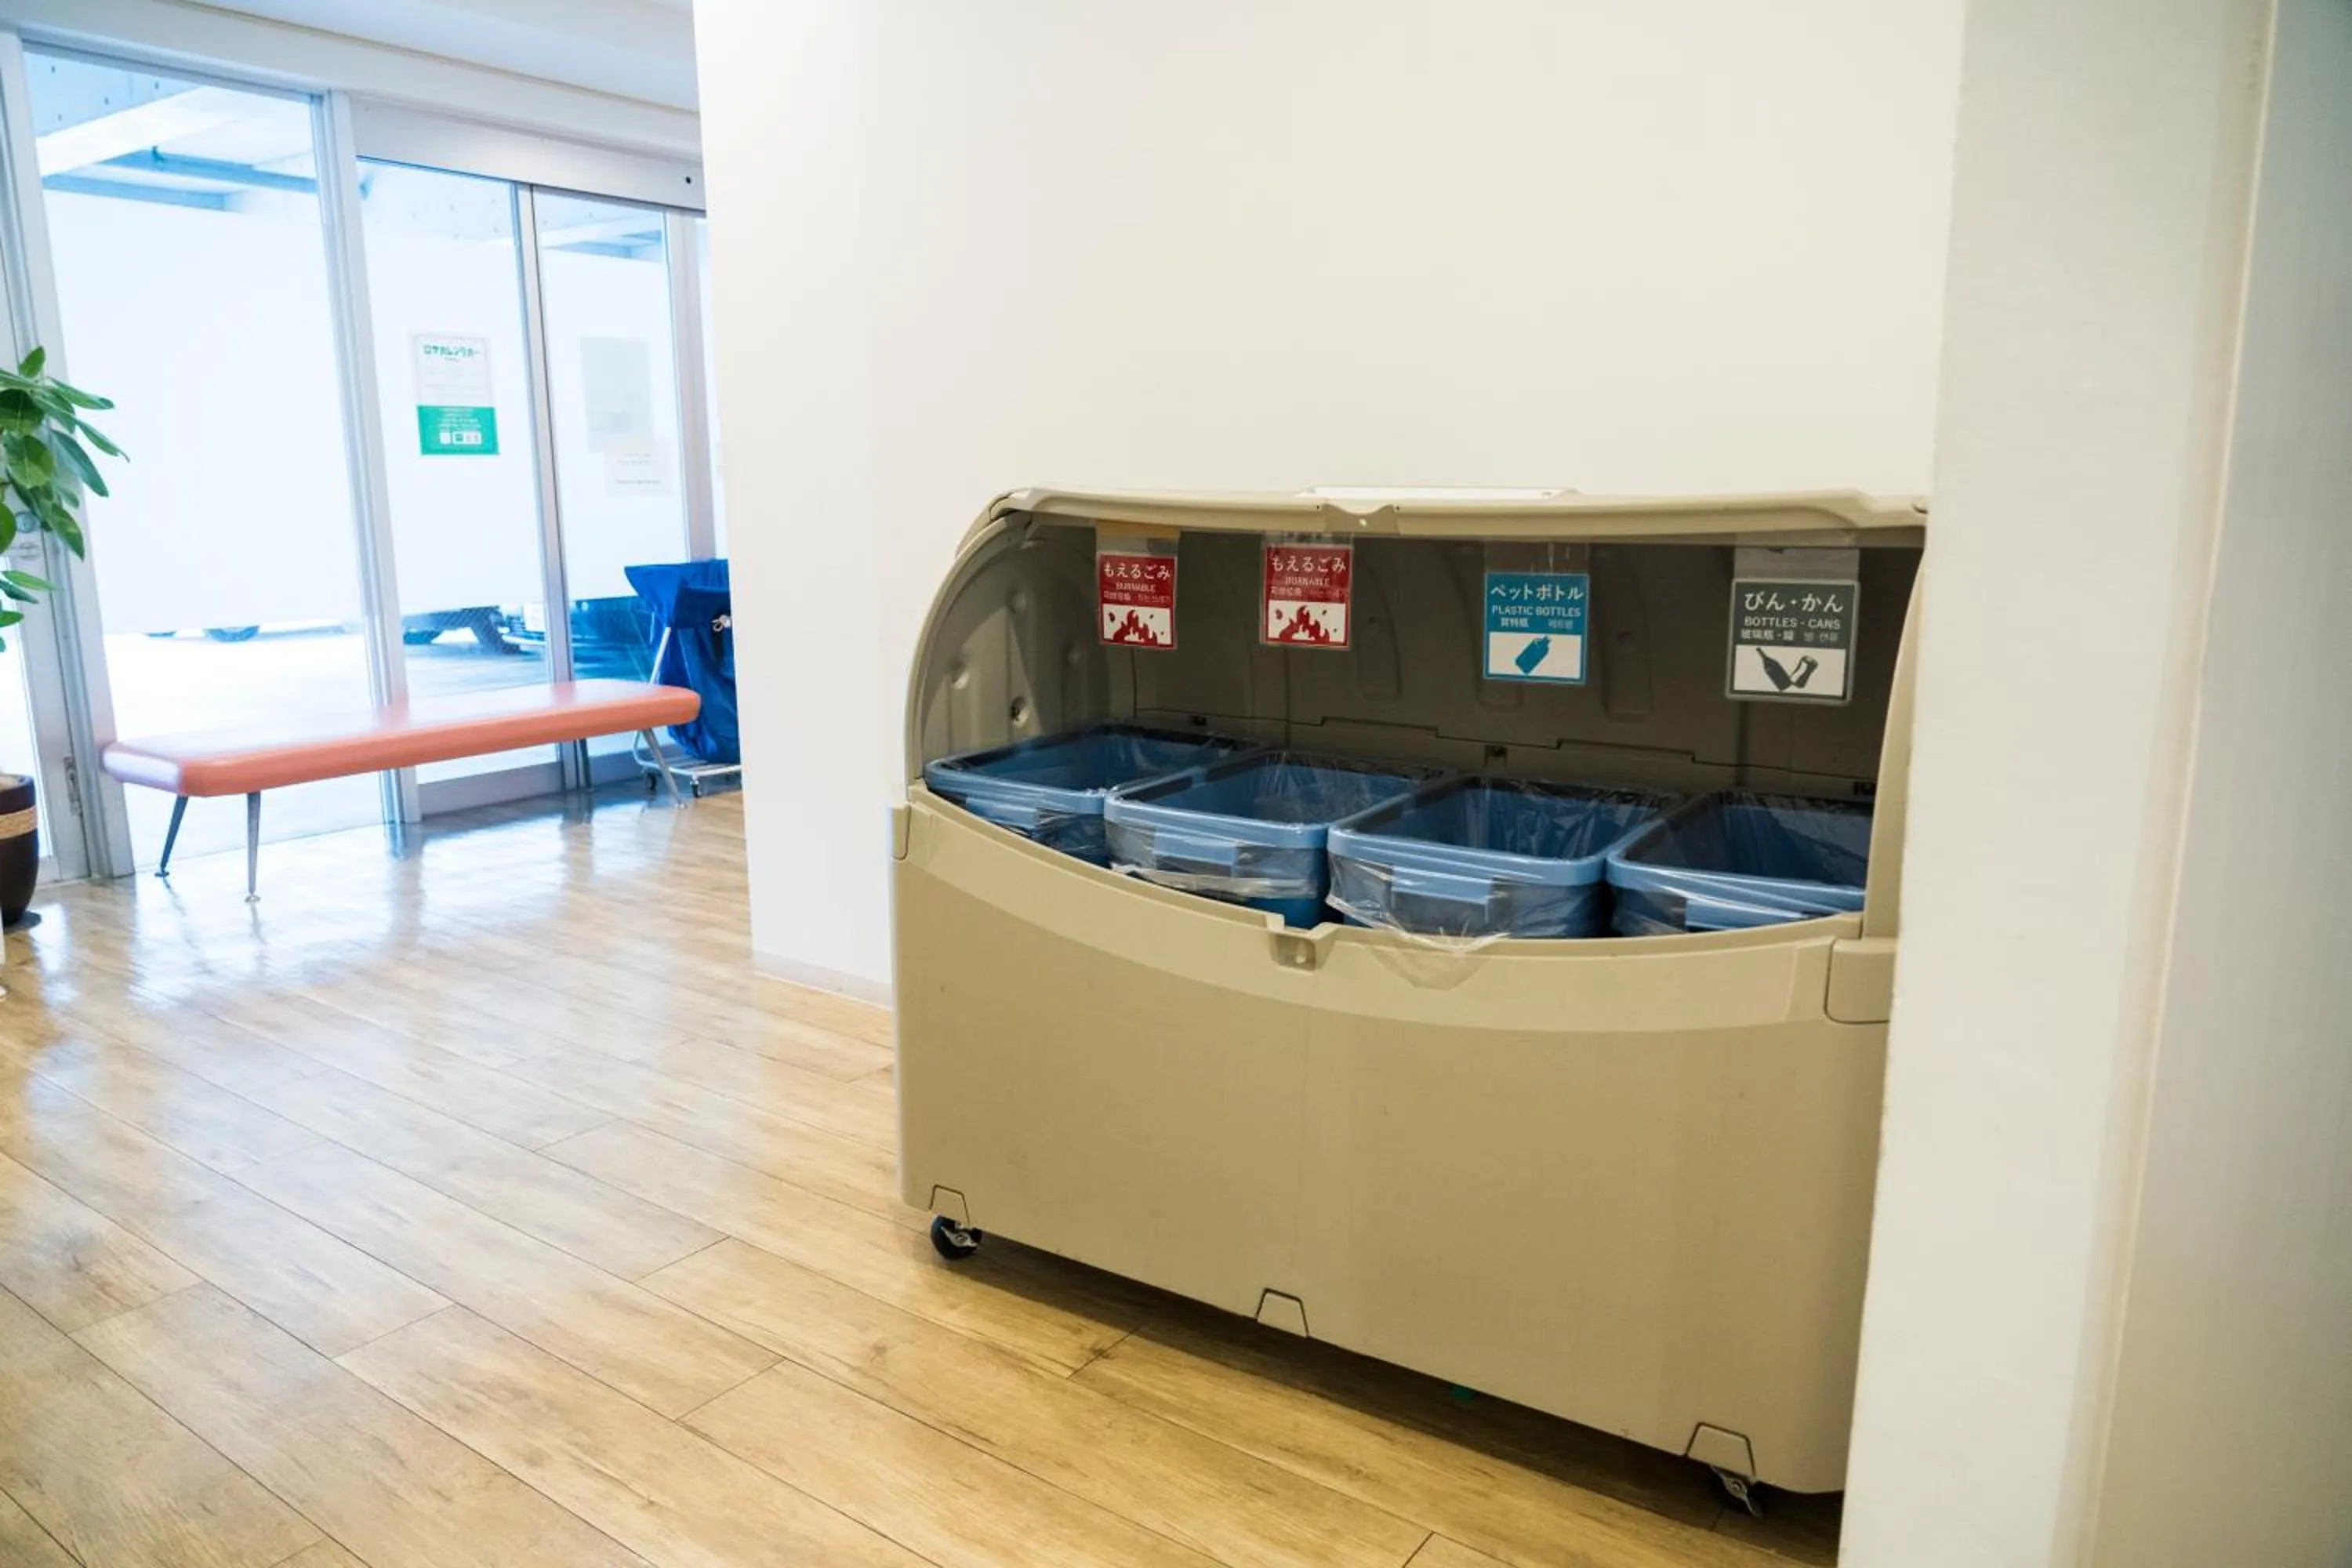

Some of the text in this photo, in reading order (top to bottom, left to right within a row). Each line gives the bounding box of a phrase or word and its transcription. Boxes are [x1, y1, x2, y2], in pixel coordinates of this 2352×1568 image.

[1103, 561, 1170, 580] もえるごみ
[1272, 554, 1345, 574] もえるごみ
[1490, 583, 1584, 601] ペットボトル
[1492, 604, 1581, 618] PLASTIC BOTTLES
[1744, 591, 1844, 613] びん・かん
[1744, 615, 1798, 628] BOTTLES
[1808, 618, 1841, 630] CANS
